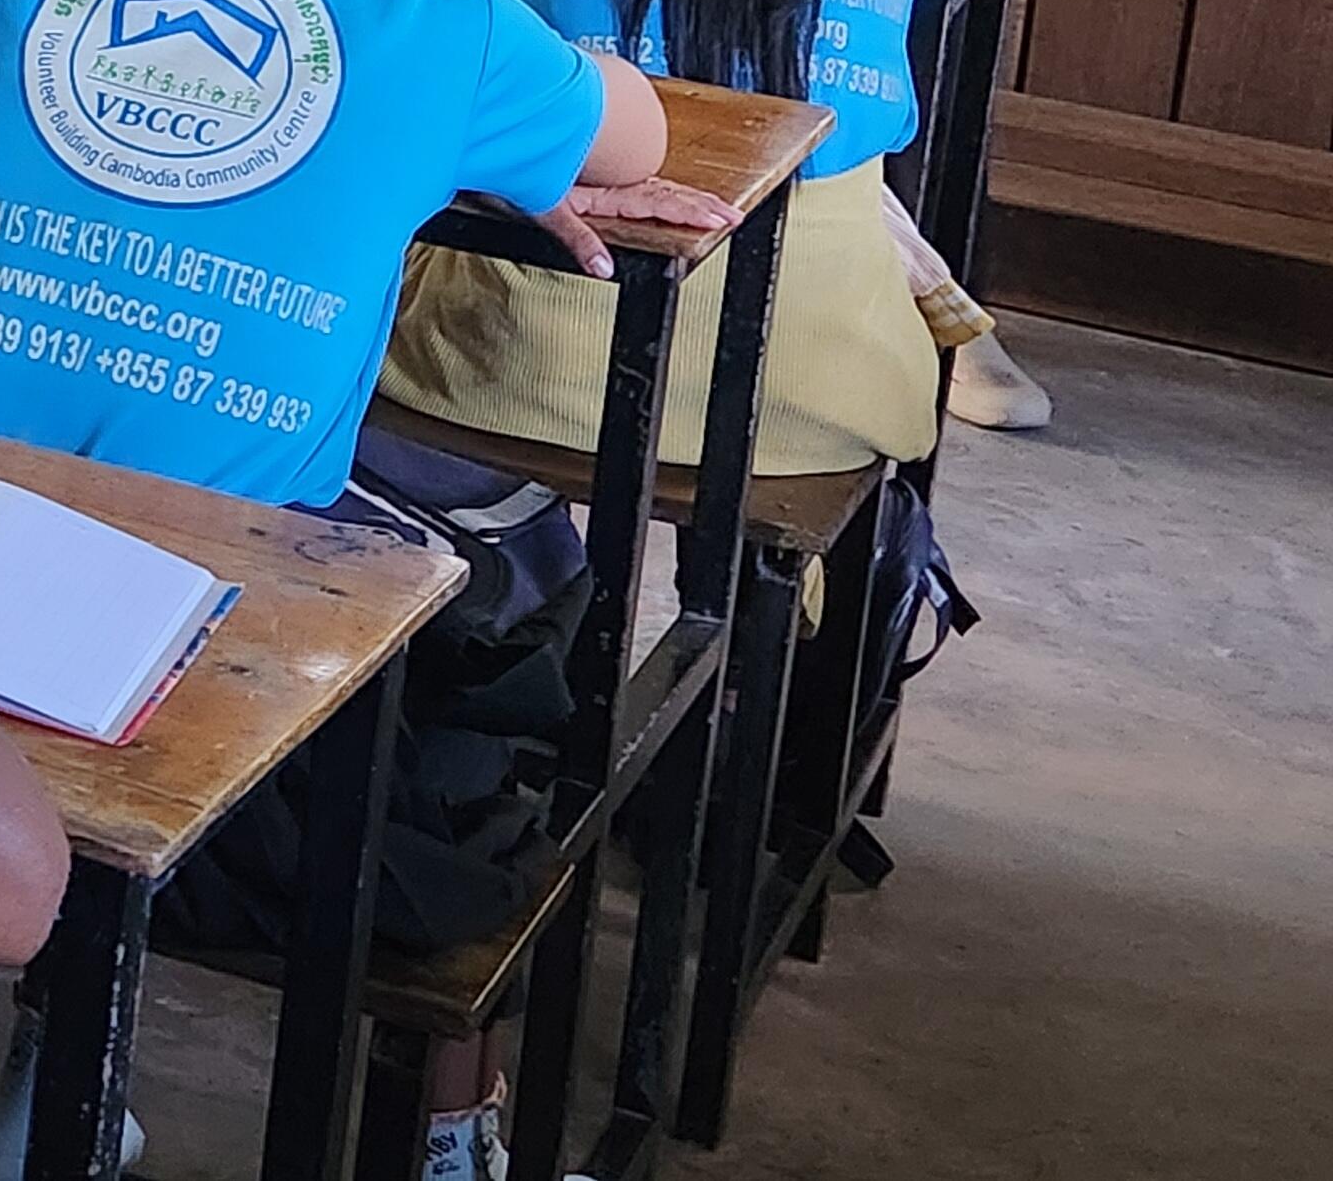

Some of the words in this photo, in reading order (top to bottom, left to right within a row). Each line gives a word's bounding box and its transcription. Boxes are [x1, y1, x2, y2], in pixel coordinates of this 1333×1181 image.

[36, 29, 64, 113] Volunteer
[822, 57, 849, 88] 87
[848, 63, 879, 96] 339
[49, 111, 101, 166] Building
[93, 90, 221, 147] VBCCC
[272, 90, 318, 149] Centre
[98, 152, 181, 190] Cambodia
[184, 147, 279, 189] Community
[5, 202, 31, 243] IS
[31, 207, 77, 256] THE
[74, 220, 121, 265] KEY
[121, 230, 155, 275] TO
[153, 242, 175, 284] A
[174, 245, 267, 311] BETTER
[27, 326, 92, 372] 913/
[95, 346, 167, 396] +855
[171, 364, 215, 406] 87
[214, 377, 269, 423] 339
